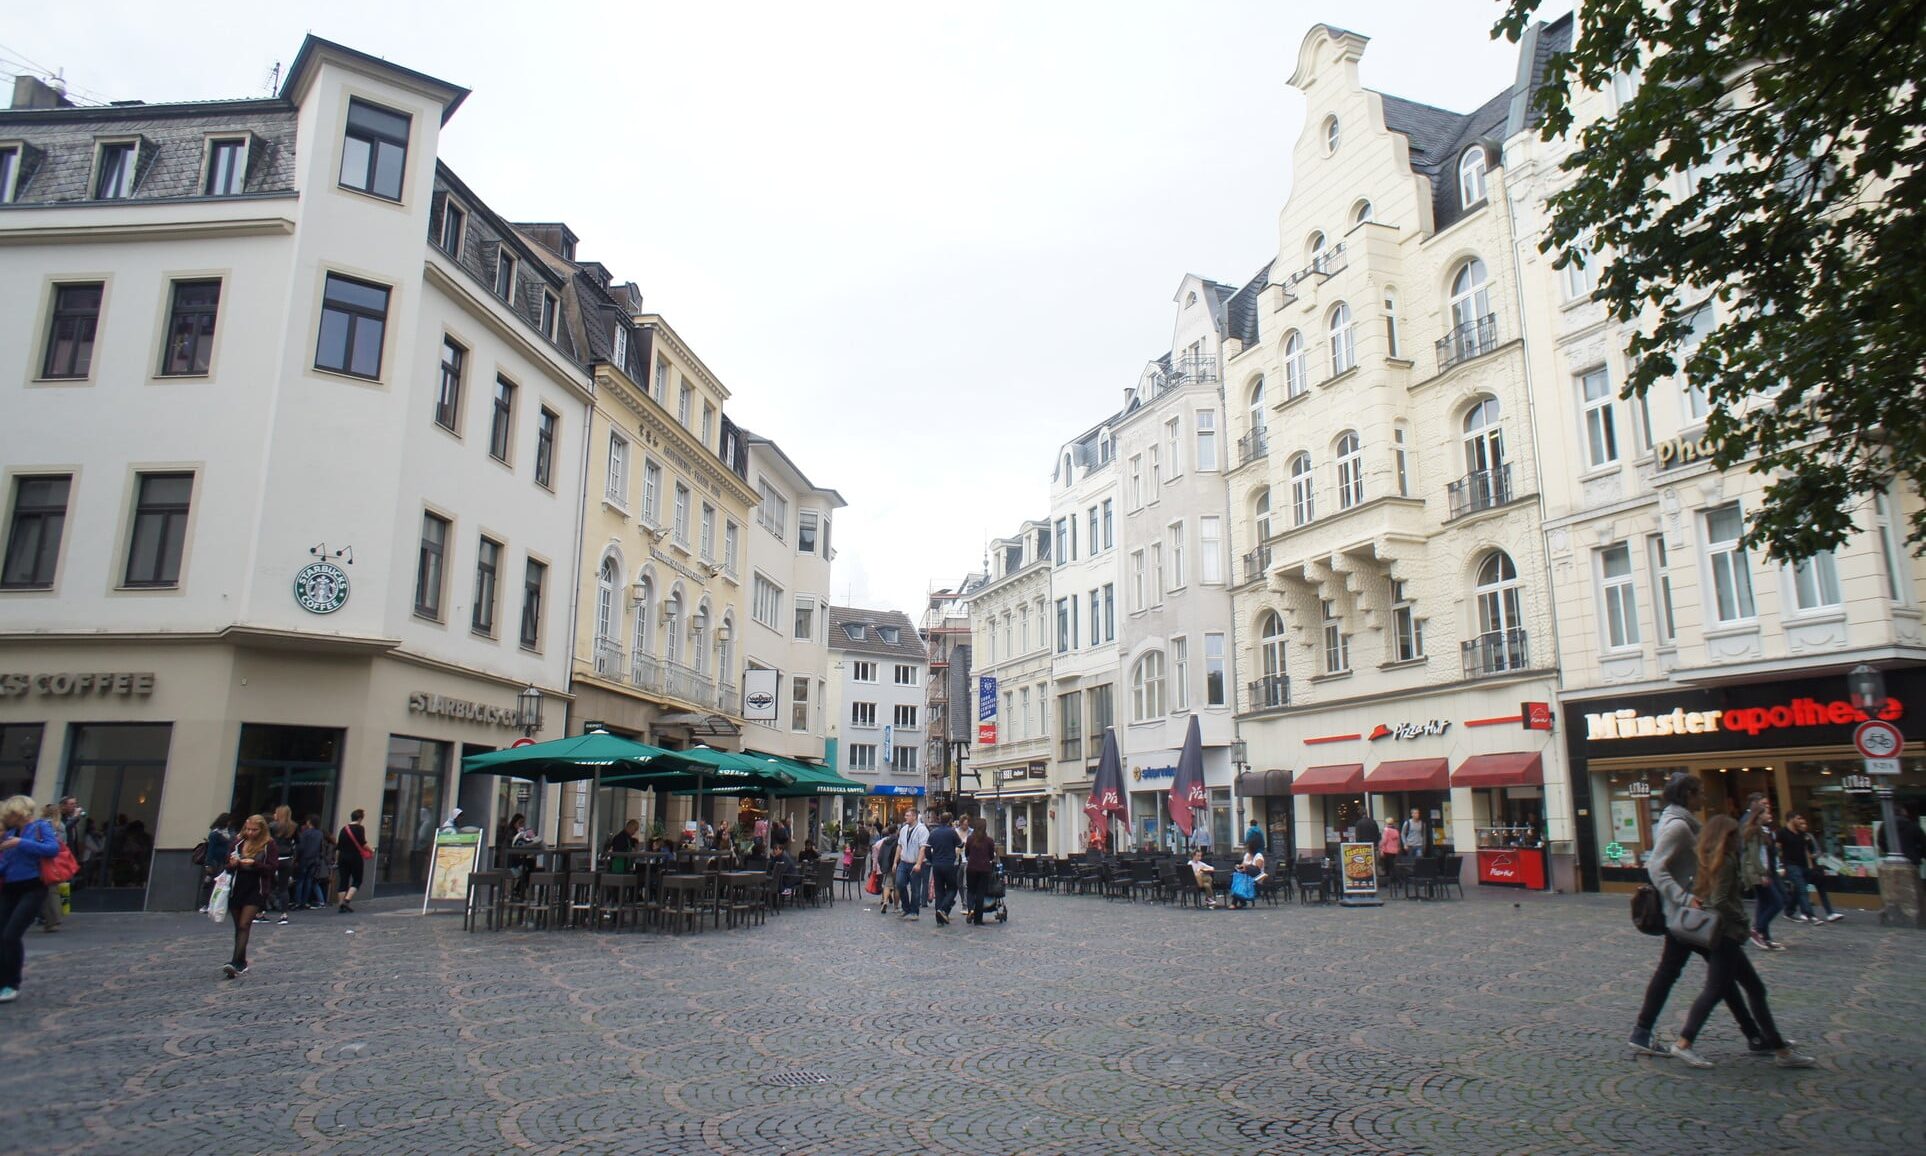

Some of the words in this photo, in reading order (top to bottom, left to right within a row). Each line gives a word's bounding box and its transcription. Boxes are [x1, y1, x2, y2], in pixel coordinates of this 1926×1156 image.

[298, 565, 347, 589] STARBUCKS
[301, 595, 340, 611] COFFEE
[32, 672, 155, 696] COFFEE
[409, 691, 499, 724] STARBUCKS
[1393, 722, 1425, 740] Pizza
[1424, 719, 1451, 736] Hut
[1584, 707, 1722, 740] Münster
[1102, 791, 1119, 806] Piz
